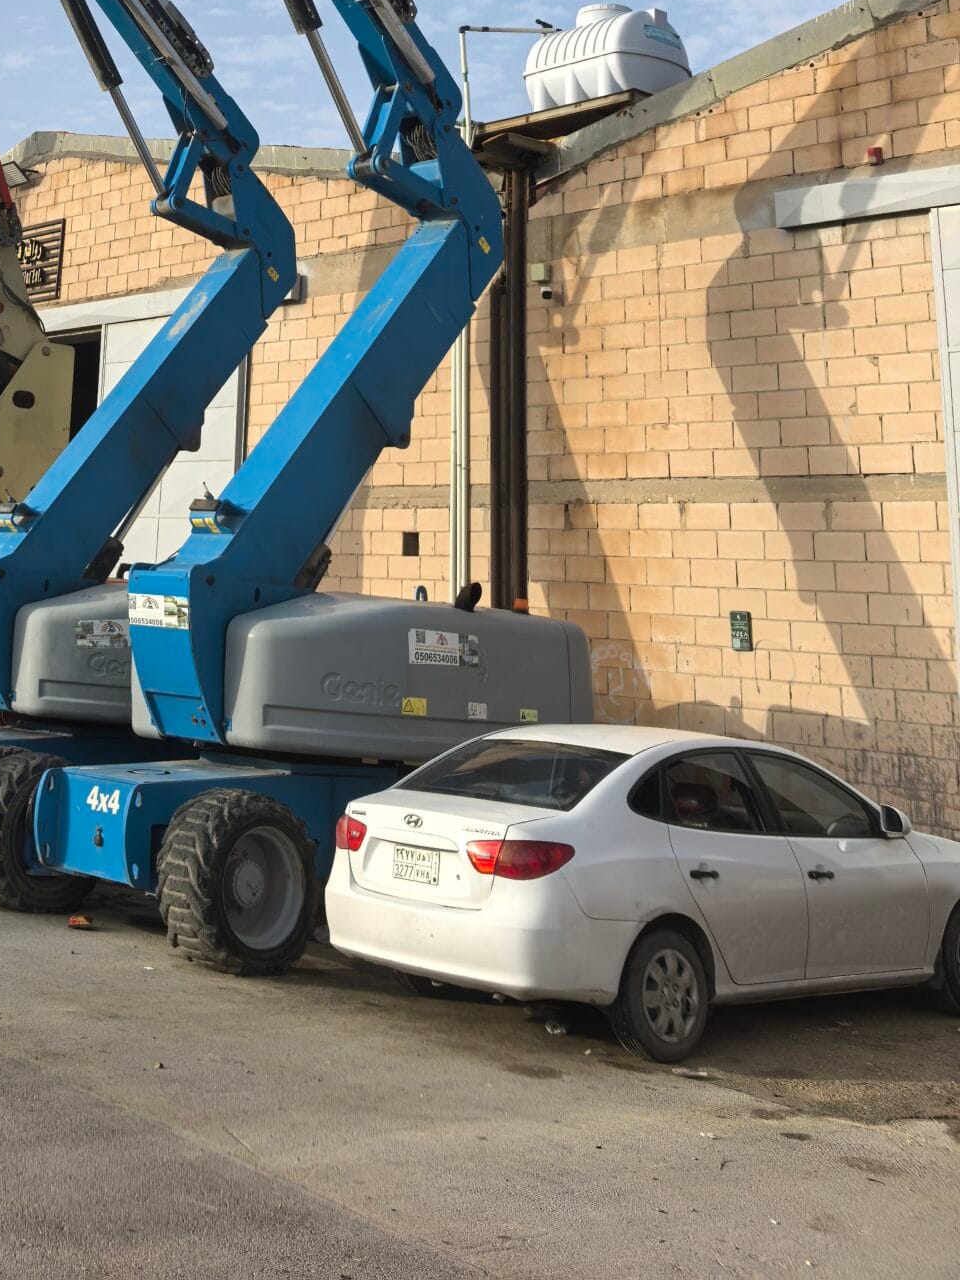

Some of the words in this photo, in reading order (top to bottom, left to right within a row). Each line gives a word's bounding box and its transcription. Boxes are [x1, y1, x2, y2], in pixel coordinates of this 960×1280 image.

[415, 651, 458, 665] 0506534006
[86, 785, 120, 815] 4x4
[394, 863, 414, 878] 3277
